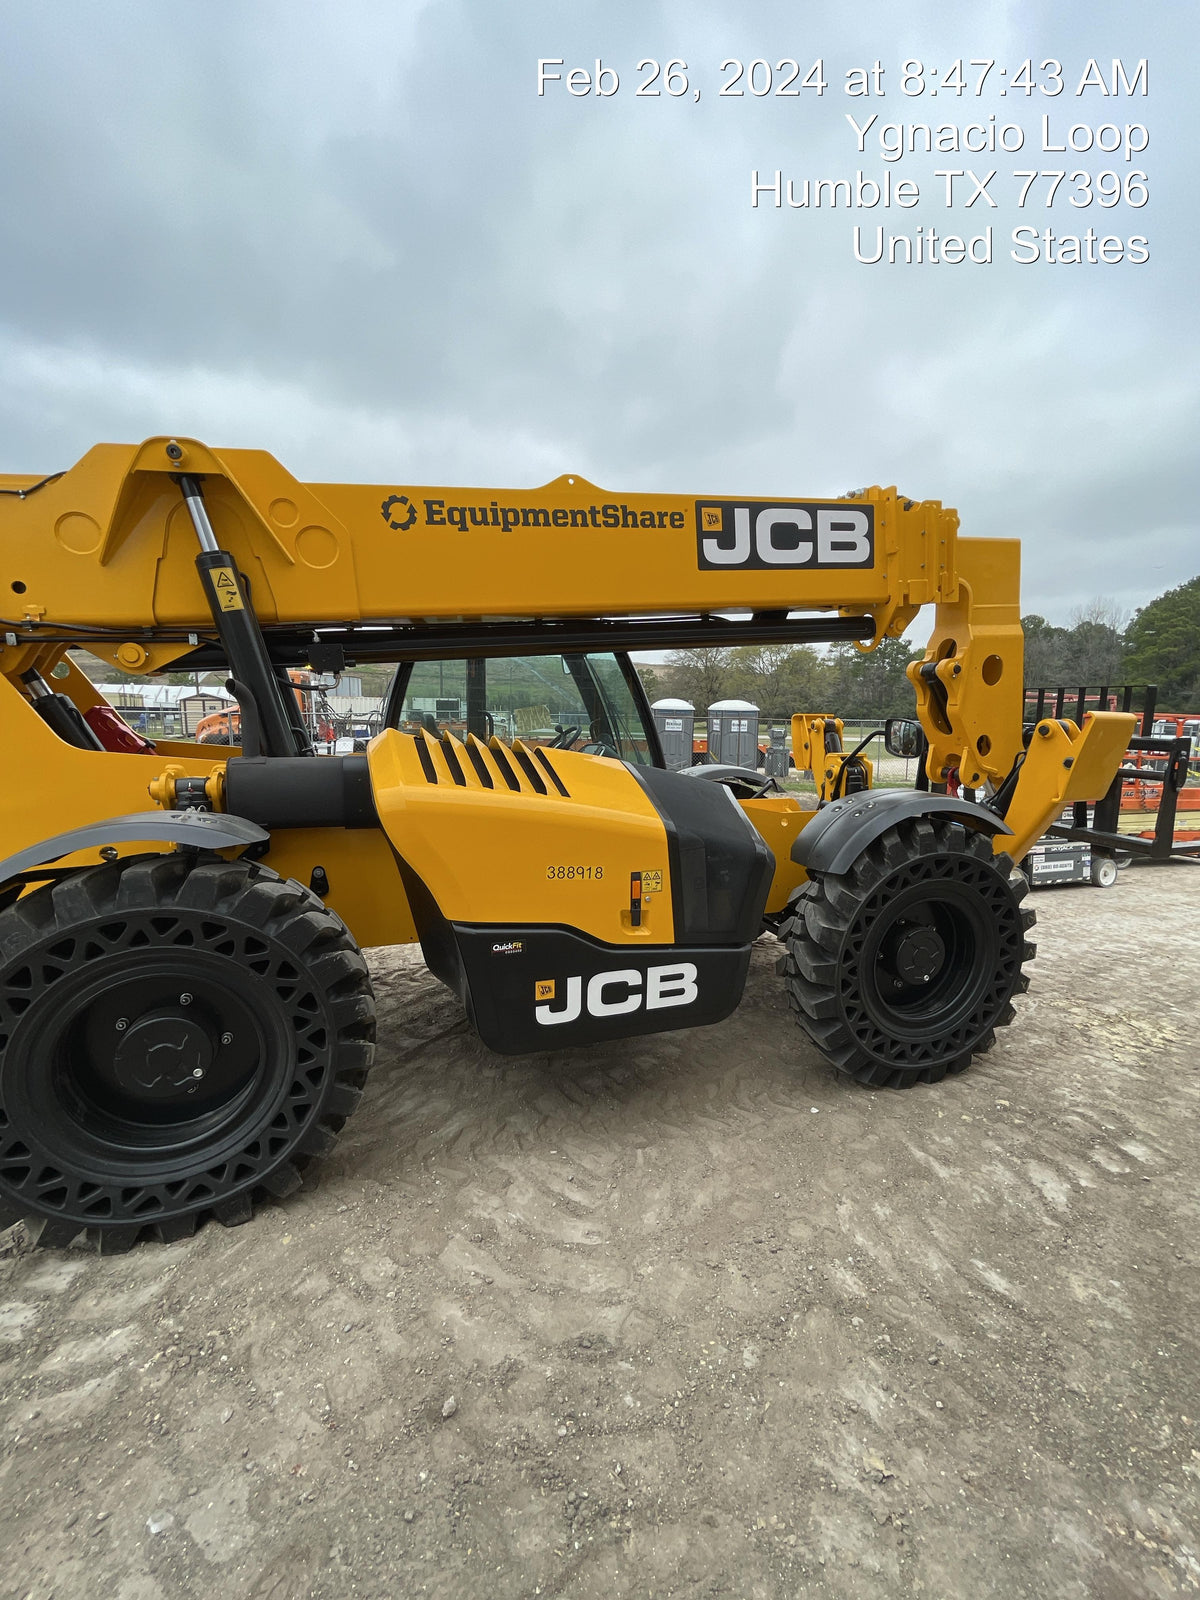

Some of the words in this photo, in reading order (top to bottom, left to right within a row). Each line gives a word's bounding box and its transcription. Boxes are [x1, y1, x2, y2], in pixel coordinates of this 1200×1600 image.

[424, 499, 685, 532] EquipmentShare
[702, 507, 870, 564] JCB
[547, 866, 603, 880] 388918
[492, 941, 523, 952] QuickFit
[535, 962, 698, 1025] JCB
